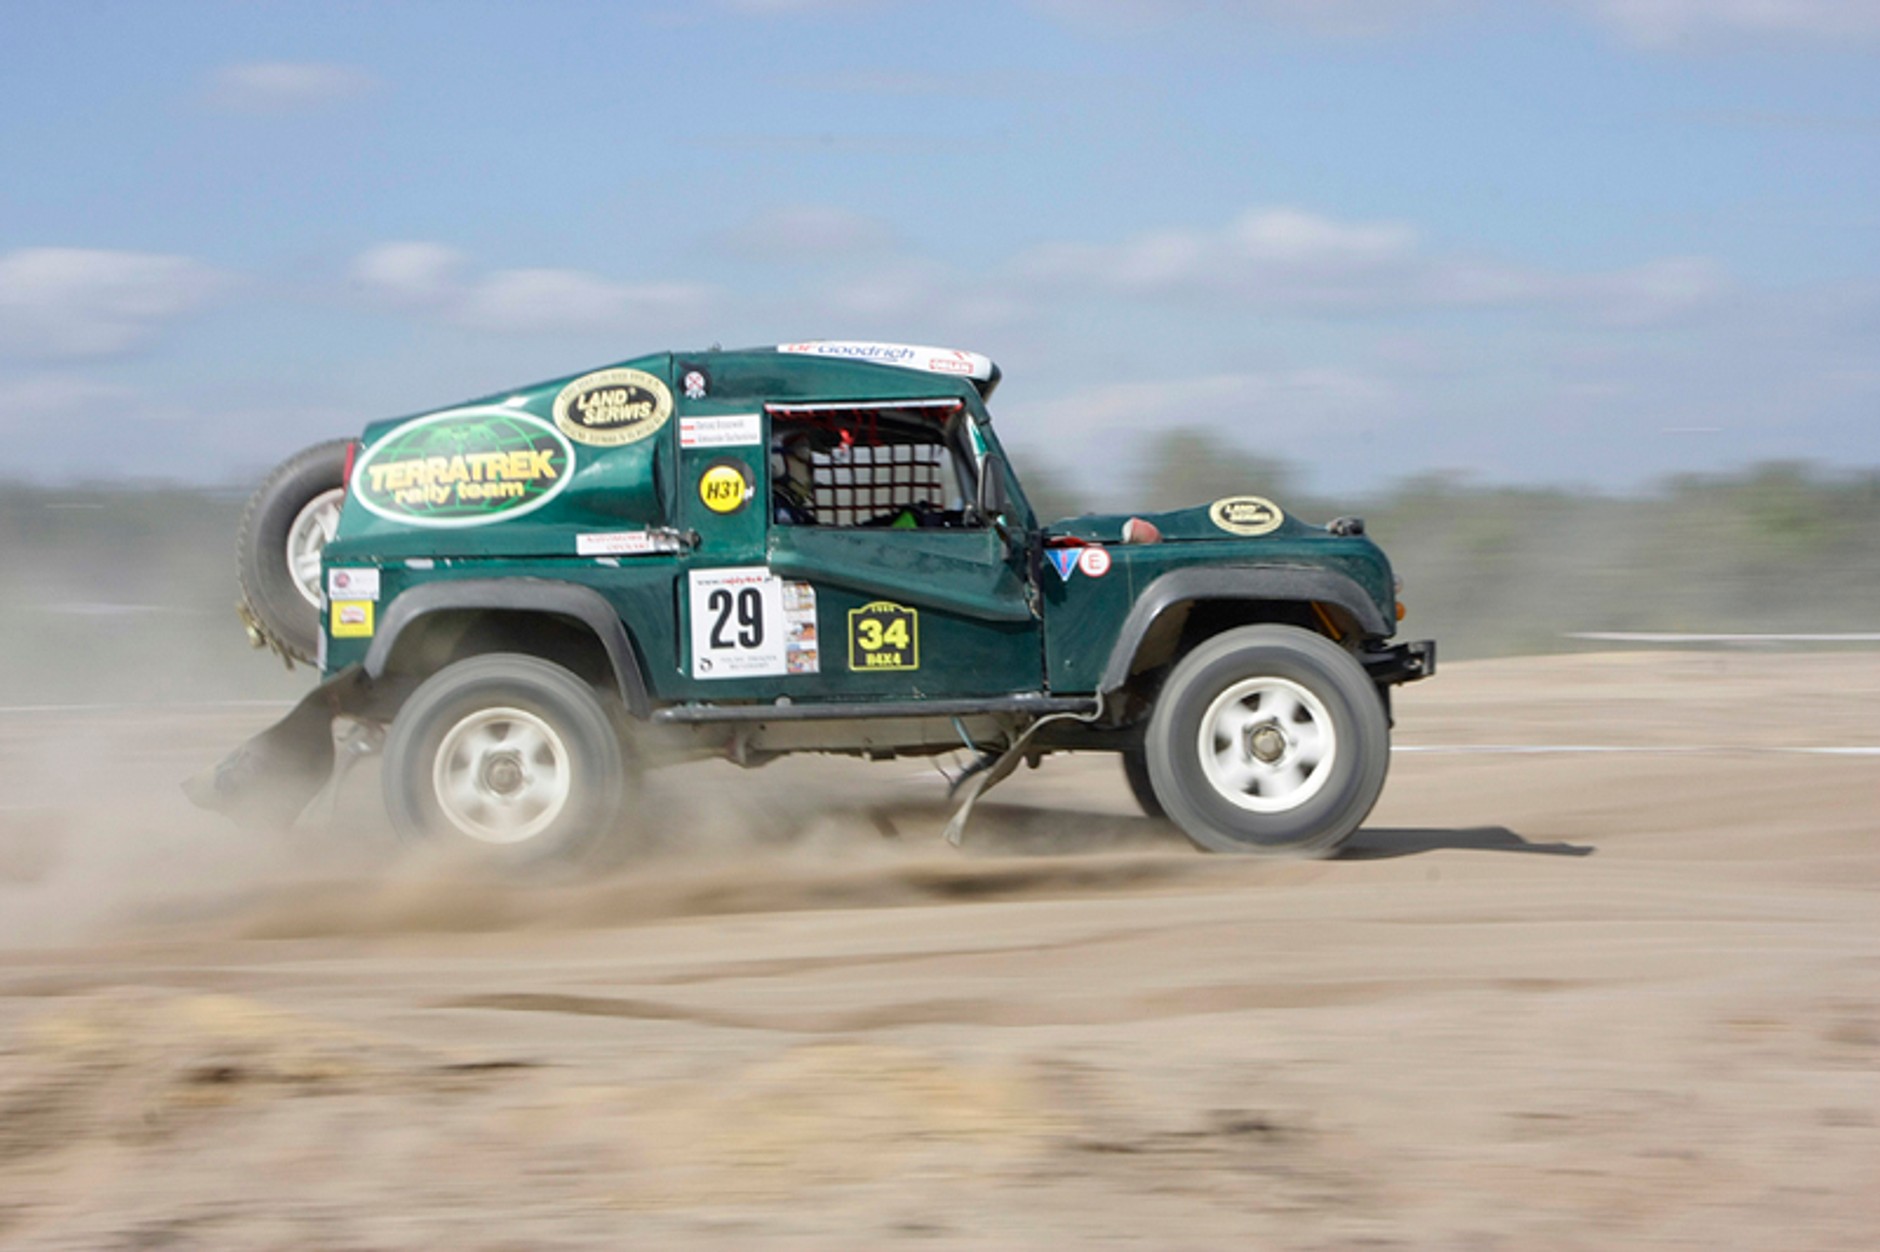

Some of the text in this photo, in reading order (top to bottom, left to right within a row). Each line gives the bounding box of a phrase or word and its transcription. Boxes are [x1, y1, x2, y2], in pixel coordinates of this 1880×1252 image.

[577, 388, 627, 410] LAND
[582, 401, 652, 425] SERWIS
[368, 450, 557, 492] TERRATREK
[394, 481, 525, 504] rally team
[1088, 553, 1104, 570] E
[708, 586, 764, 650] 29
[858, 618, 910, 651] 34
